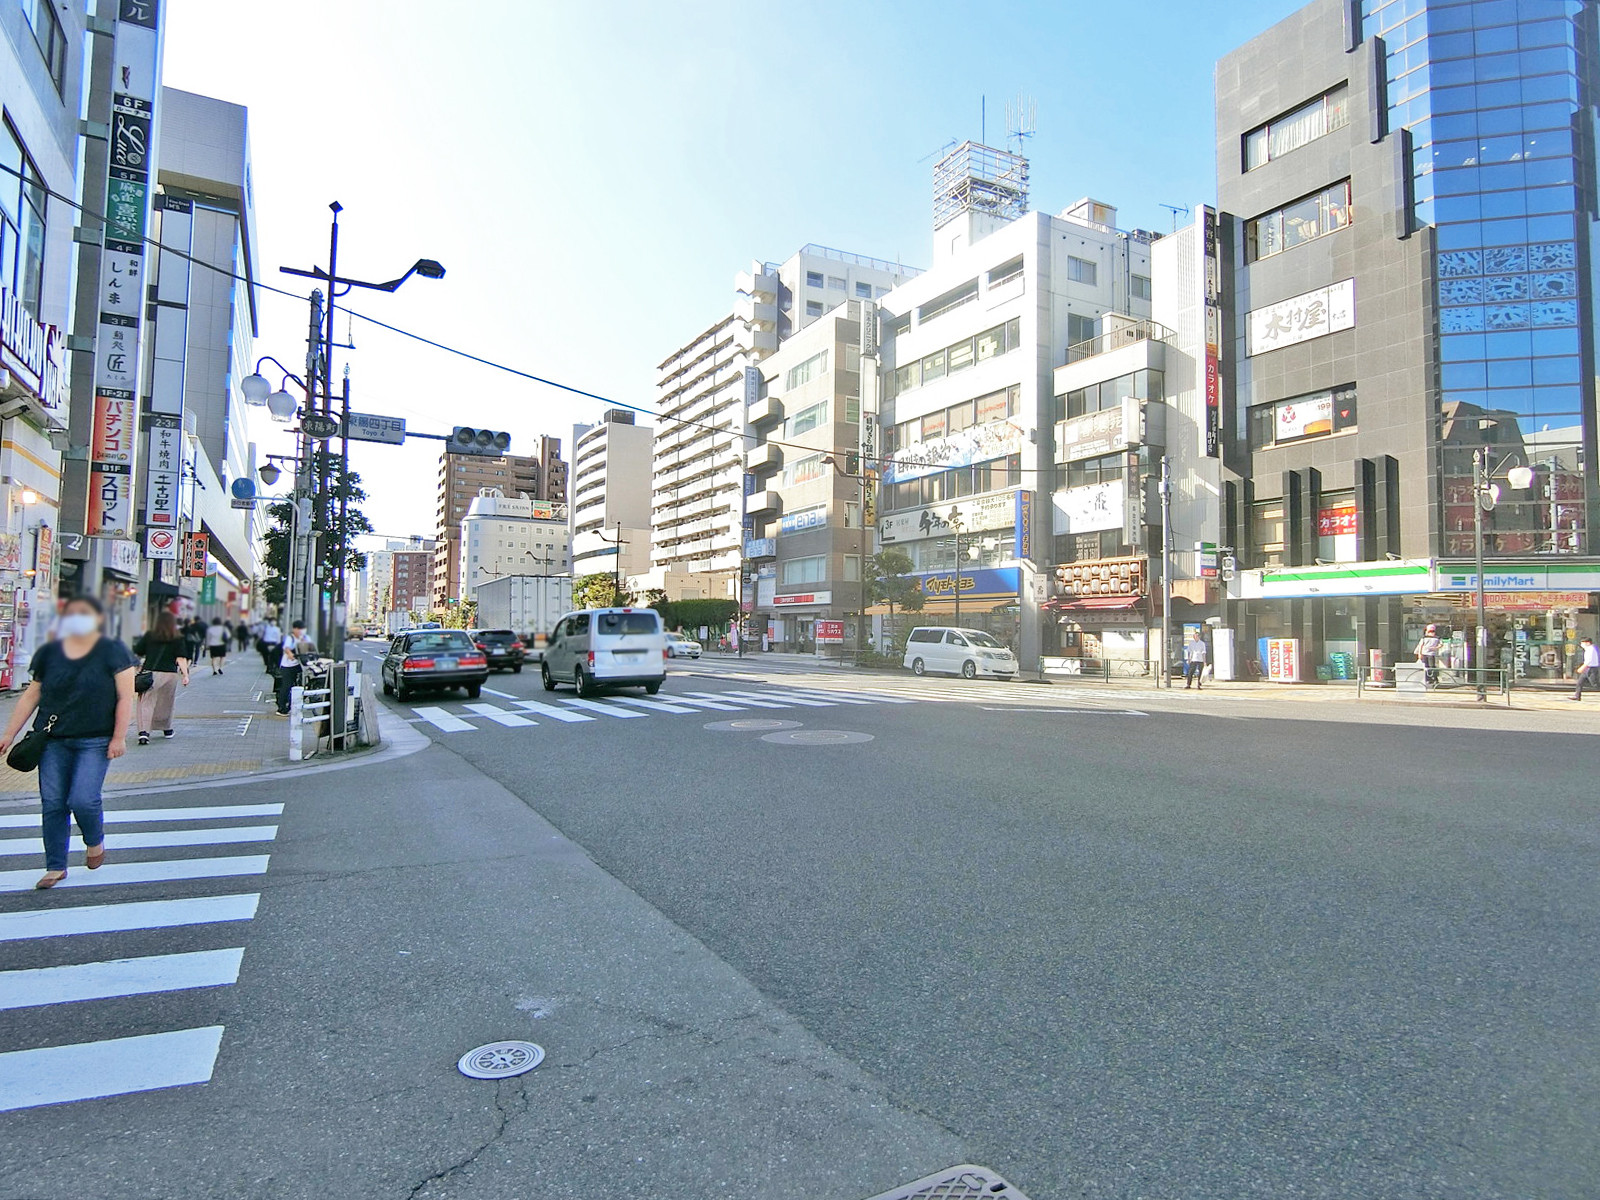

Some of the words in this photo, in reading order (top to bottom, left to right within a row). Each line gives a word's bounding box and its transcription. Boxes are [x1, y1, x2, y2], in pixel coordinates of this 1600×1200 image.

[123, 97, 143, 109] 6F
[120, 172, 137, 181] 5F
[117, 244, 133, 253] 4F
[111, 317, 128, 326] 3F
[1262, 301, 1326, 340] 木村屋
[1208, 364, 1216, 405] カラオケ
[105, 401, 124, 451] パチンコ
[155, 419, 177, 428] 2-3F
[304, 420, 337, 434] 東陽町
[348, 416, 402, 432] 東陽四丁目
[362, 429, 378, 438] Toyo
[159, 429, 172, 469] 和牛焼肉
[102, 464, 121, 472] B1F
[154, 474, 172, 511] 土古里
[102, 476, 118, 526] スロット
[797, 512, 816, 528] ena
[1470, 576, 1535, 587] FmilyMart
